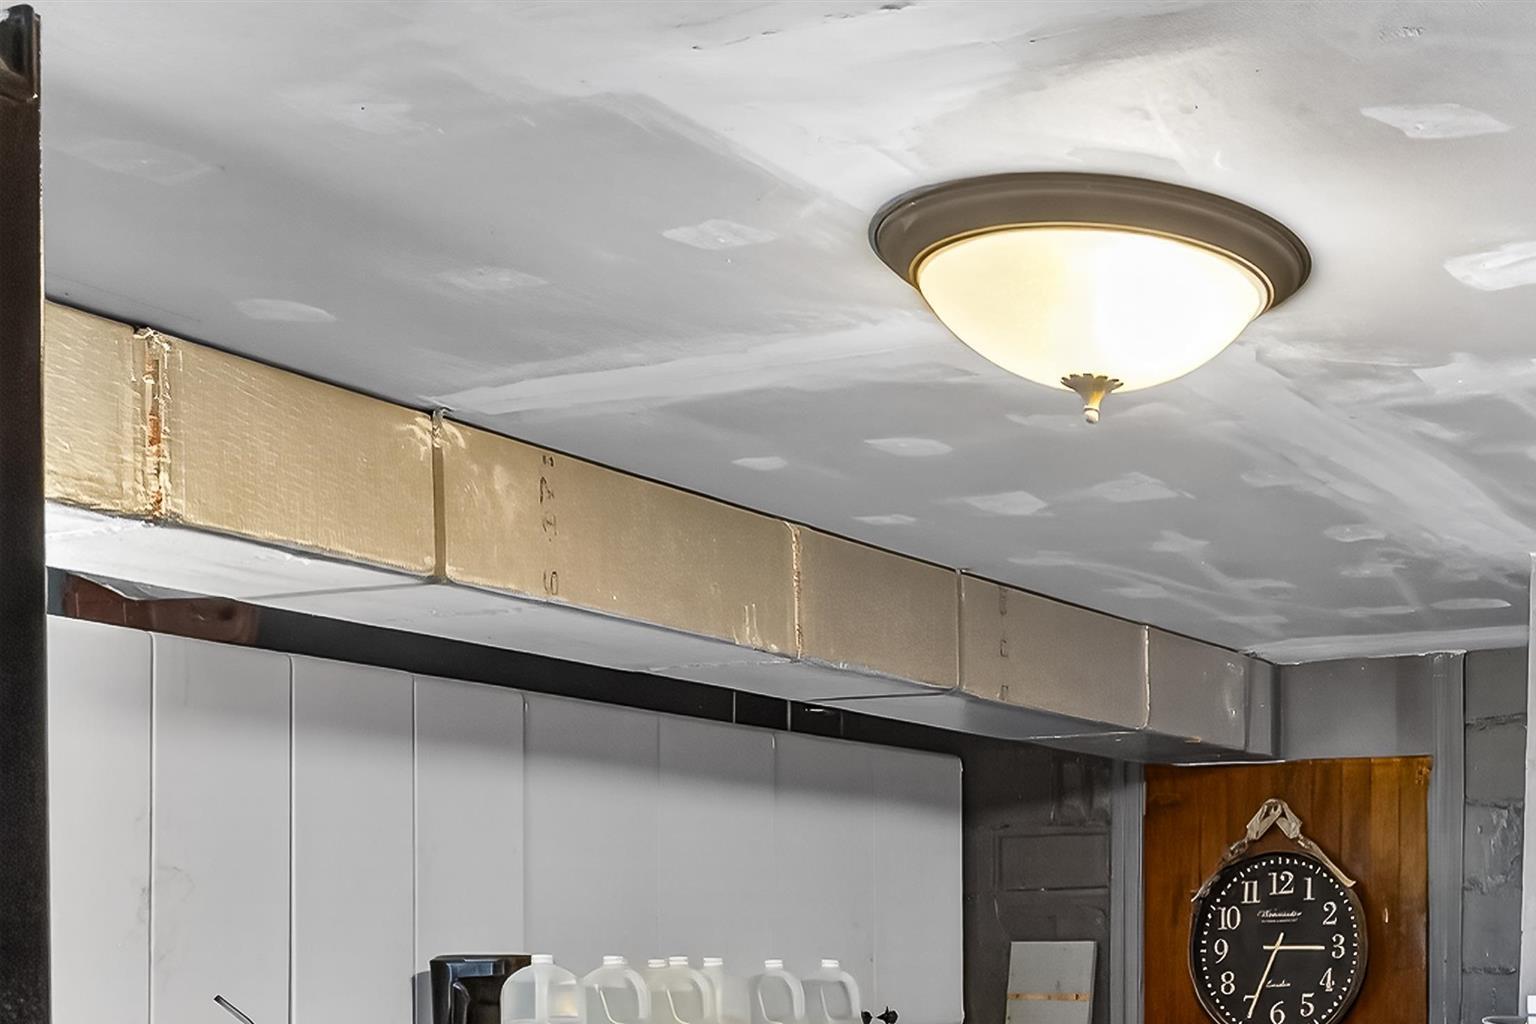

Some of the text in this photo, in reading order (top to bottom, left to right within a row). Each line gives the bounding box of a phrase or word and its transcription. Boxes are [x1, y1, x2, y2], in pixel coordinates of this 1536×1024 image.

[1241, 880, 1260, 904] 11
[1267, 871, 1294, 896] 12
[1303, 877, 1315, 900] 1
[1217, 905, 1241, 931] 10
[1322, 902, 1337, 926] 2
[1214, 938, 1229, 964] 9
[1331, 934, 1345, 959] 3
[1220, 970, 1236, 995] 8
[1319, 967, 1335, 992] 4
[1243, 994, 1258, 1019] 7
[1270, 1000, 1286, 1024] 6
[1300, 992, 1315, 1017] 5
